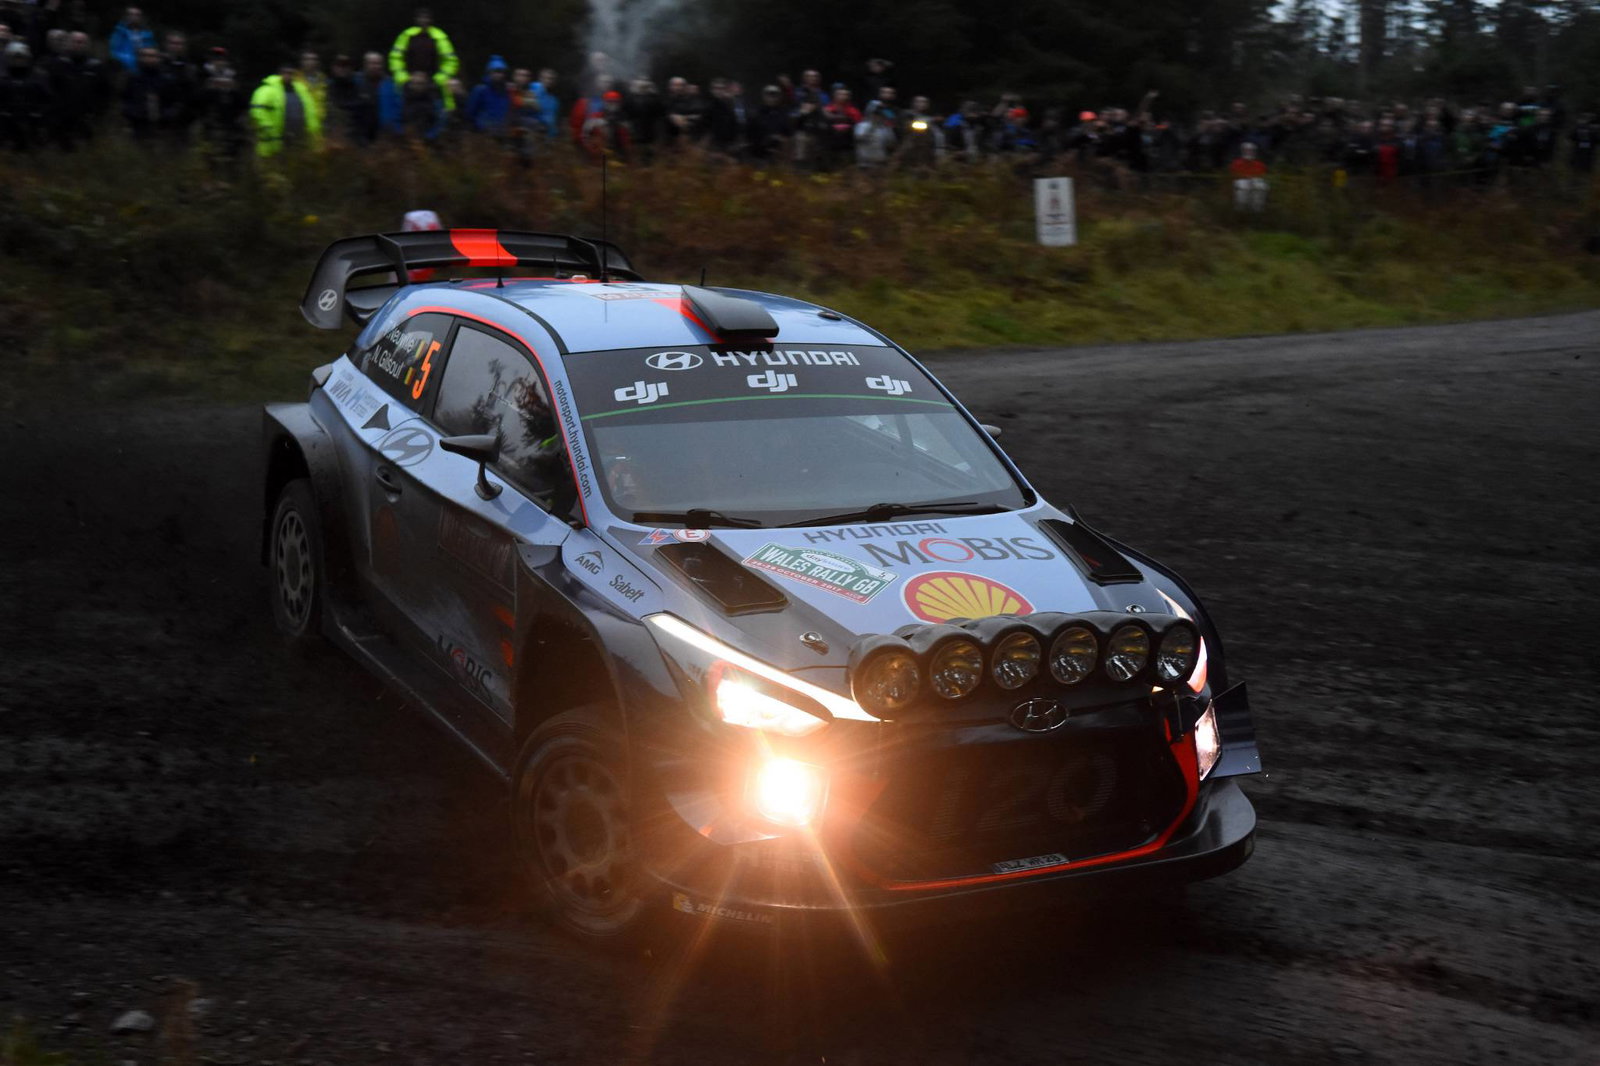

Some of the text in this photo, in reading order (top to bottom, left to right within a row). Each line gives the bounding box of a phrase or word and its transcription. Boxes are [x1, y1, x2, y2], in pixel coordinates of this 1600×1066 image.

[379, 349, 405, 379] Gilsoul
[412, 340, 441, 399] 5
[710, 350, 860, 366] HYUNDAI
[554, 380, 592, 498] motorsport.hyundai.com
[685, 530, 700, 539] E
[803, 523, 948, 543] HYUNDAI
[575, 555, 602, 575] AMG
[858, 537, 1055, 568] MOBIS
[760, 547, 811, 572] WALES
[808, 565, 858, 587] RALLY
[852, 578, 880, 595] GB
[609, 574, 646, 602] Sabelt
